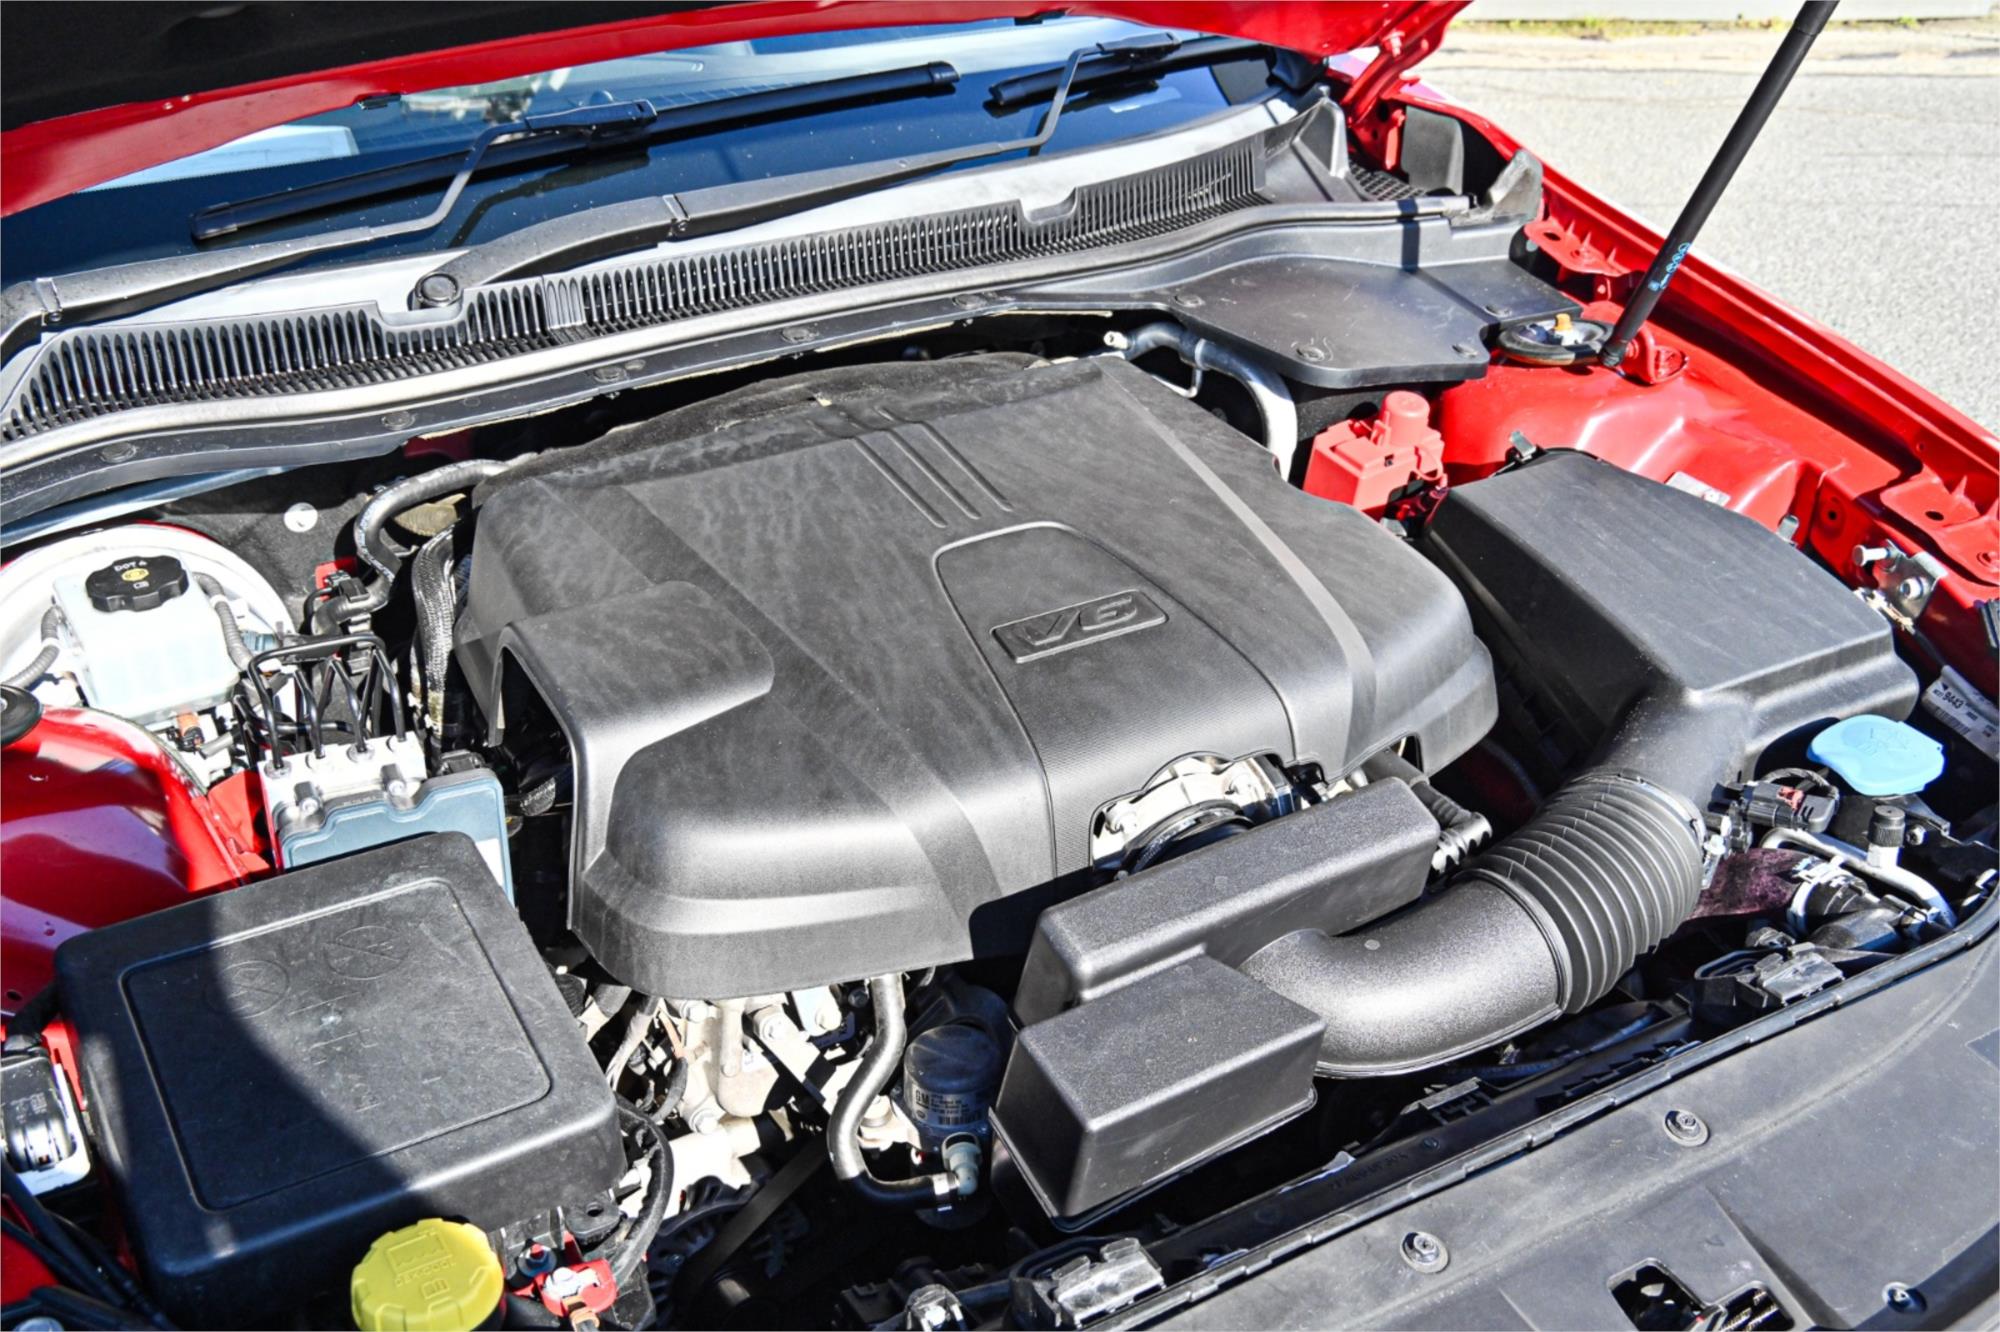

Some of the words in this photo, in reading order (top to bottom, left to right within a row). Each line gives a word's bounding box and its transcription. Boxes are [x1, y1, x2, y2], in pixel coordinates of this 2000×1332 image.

[113, 561, 137, 573] DOT
[1012, 595, 1138, 647] V6
[915, 1088, 930, 1105] GM
